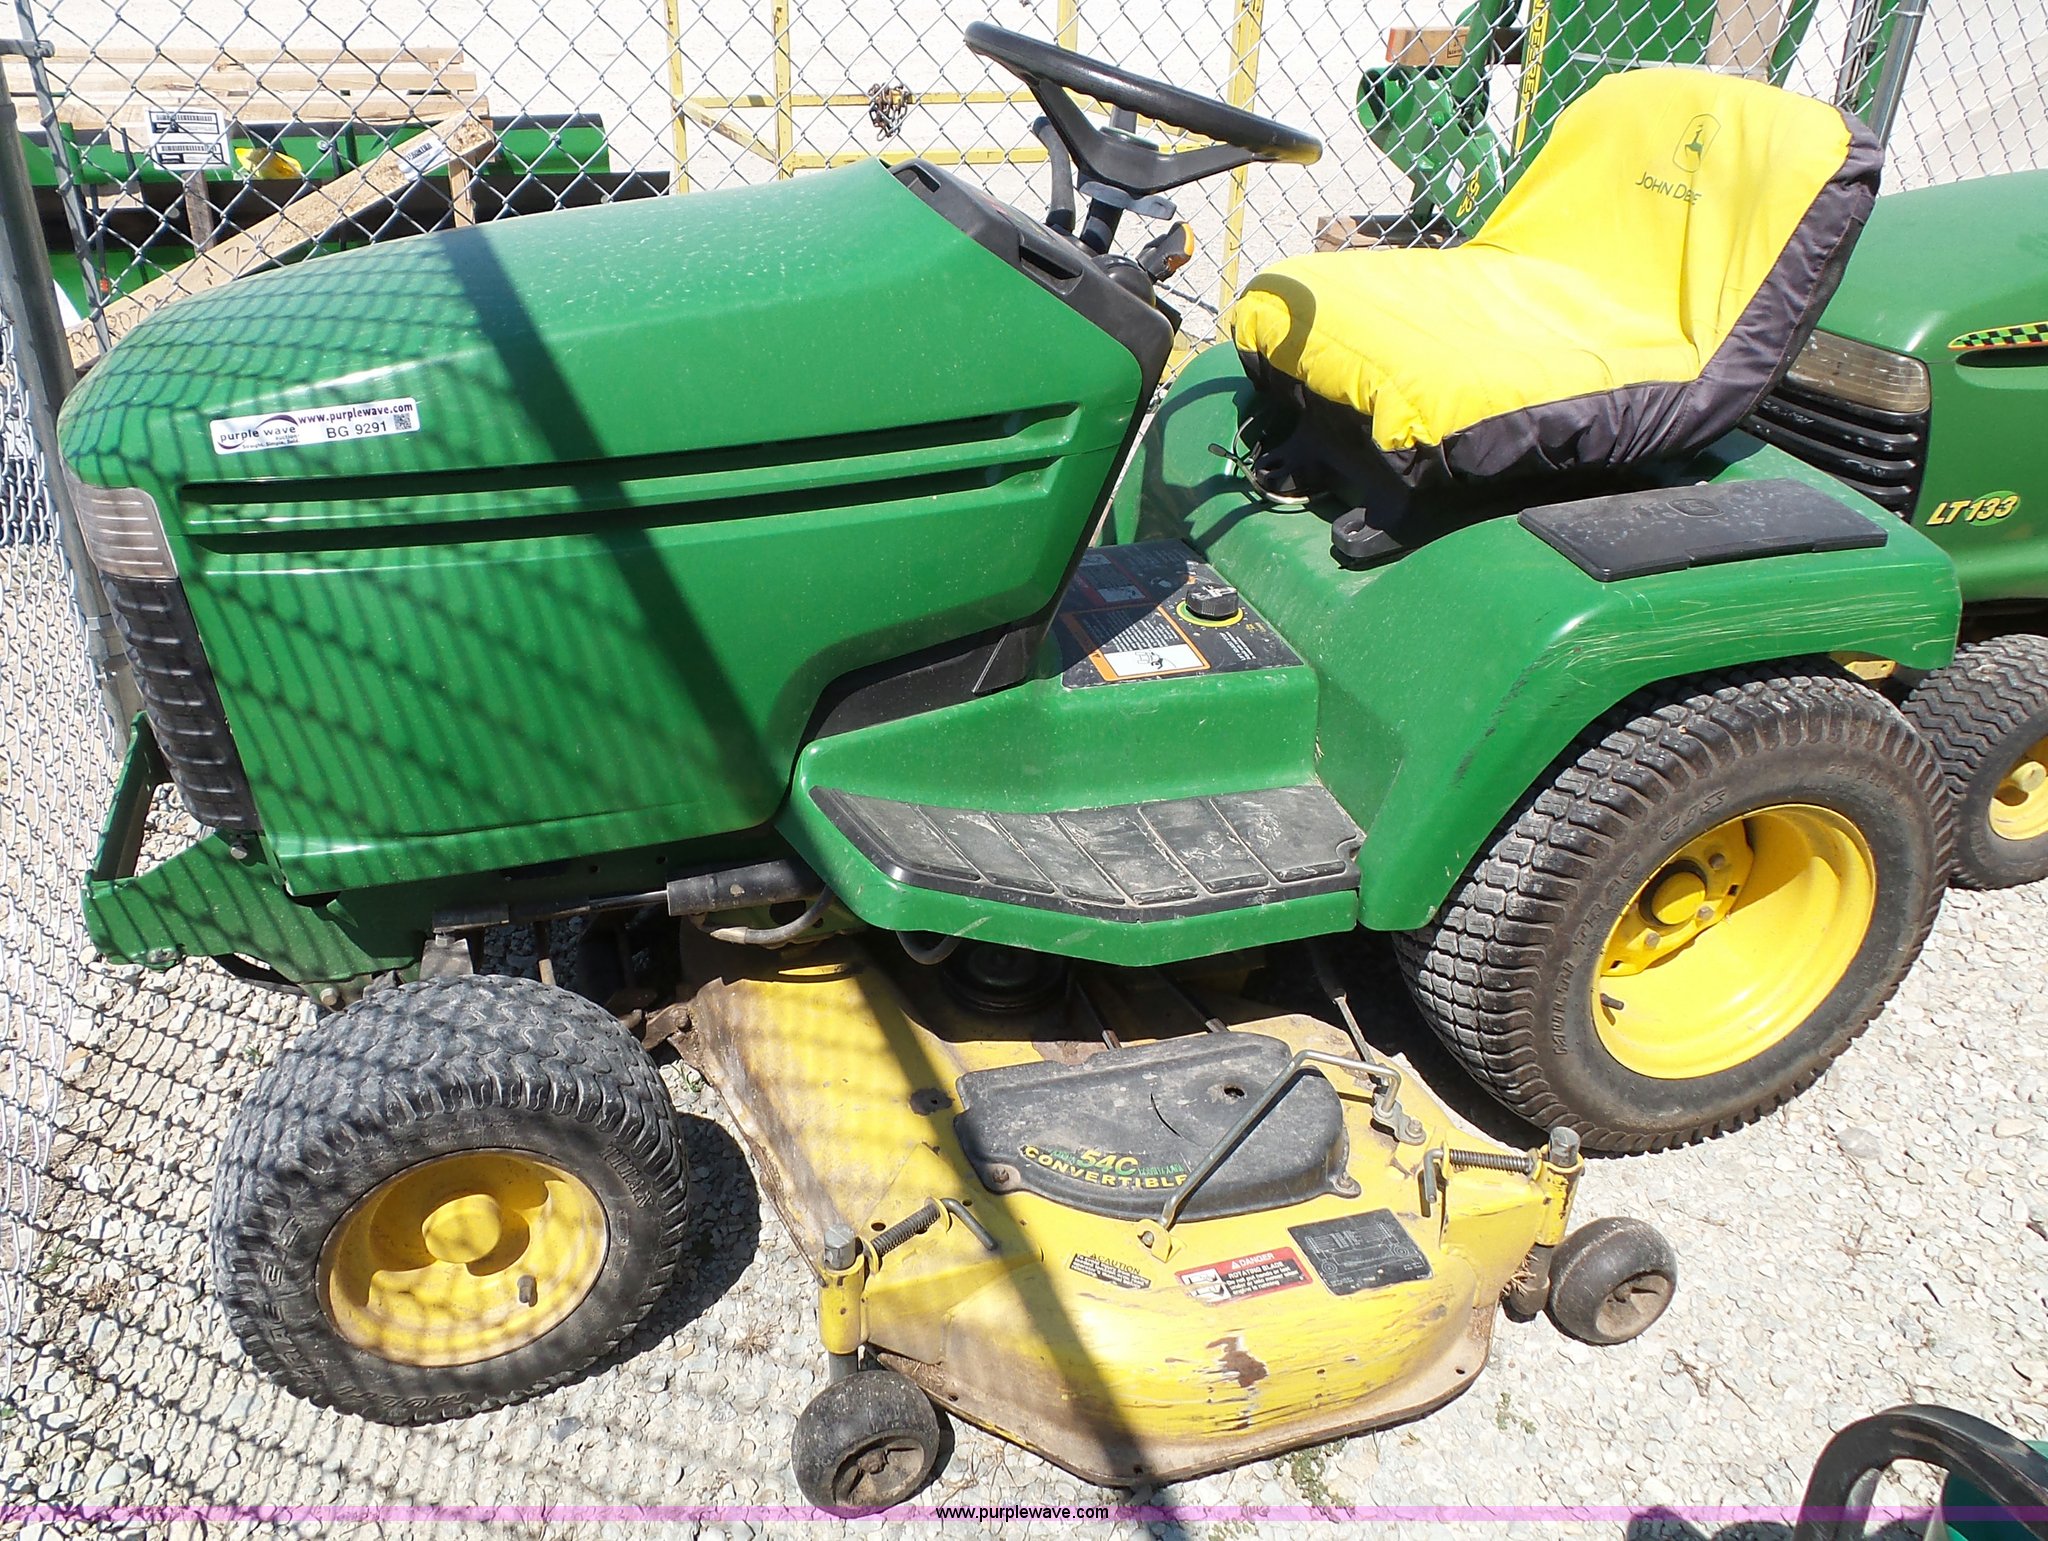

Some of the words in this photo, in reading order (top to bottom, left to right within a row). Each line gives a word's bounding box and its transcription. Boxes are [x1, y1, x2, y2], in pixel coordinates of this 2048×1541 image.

[1635, 171, 1673, 196] JOHN
[298, 402, 413, 424] www.purplewave.com
[220, 429, 260, 443] purple
[263, 425, 296, 436] wave
[326, 425, 349, 439] BG
[355, 420, 388, 436] 9291
[1926, 494, 2019, 526] LT133
[1077, 1148, 1139, 1177] 54C
[599, 1141, 654, 1208] TITAN
[1097, 1255, 1141, 1275] CAUTION
[1239, 1252, 1275, 1267] DANGER
